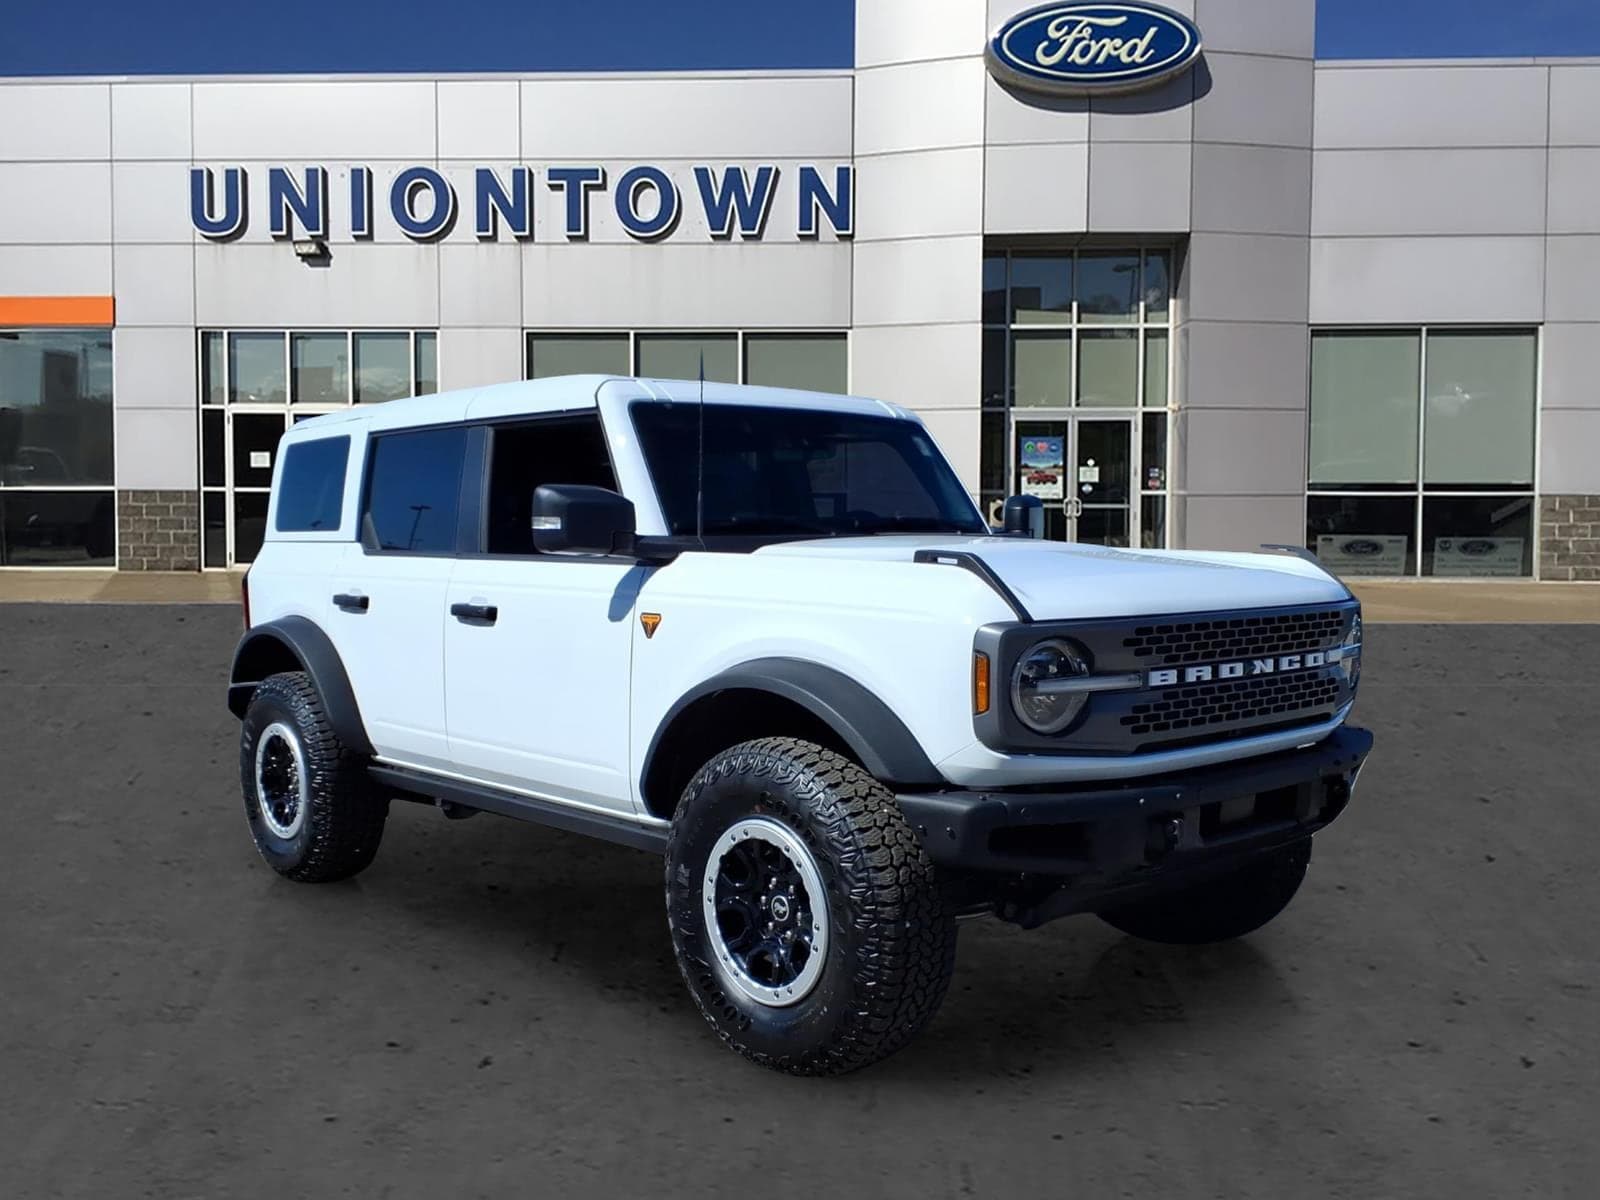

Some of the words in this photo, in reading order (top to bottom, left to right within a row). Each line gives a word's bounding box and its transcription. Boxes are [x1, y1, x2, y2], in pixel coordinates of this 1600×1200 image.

[1036, 16, 1158, 66] Ford
[189, 166, 855, 243] UNIONTOWN
[1148, 651, 1325, 687] BRONCO
